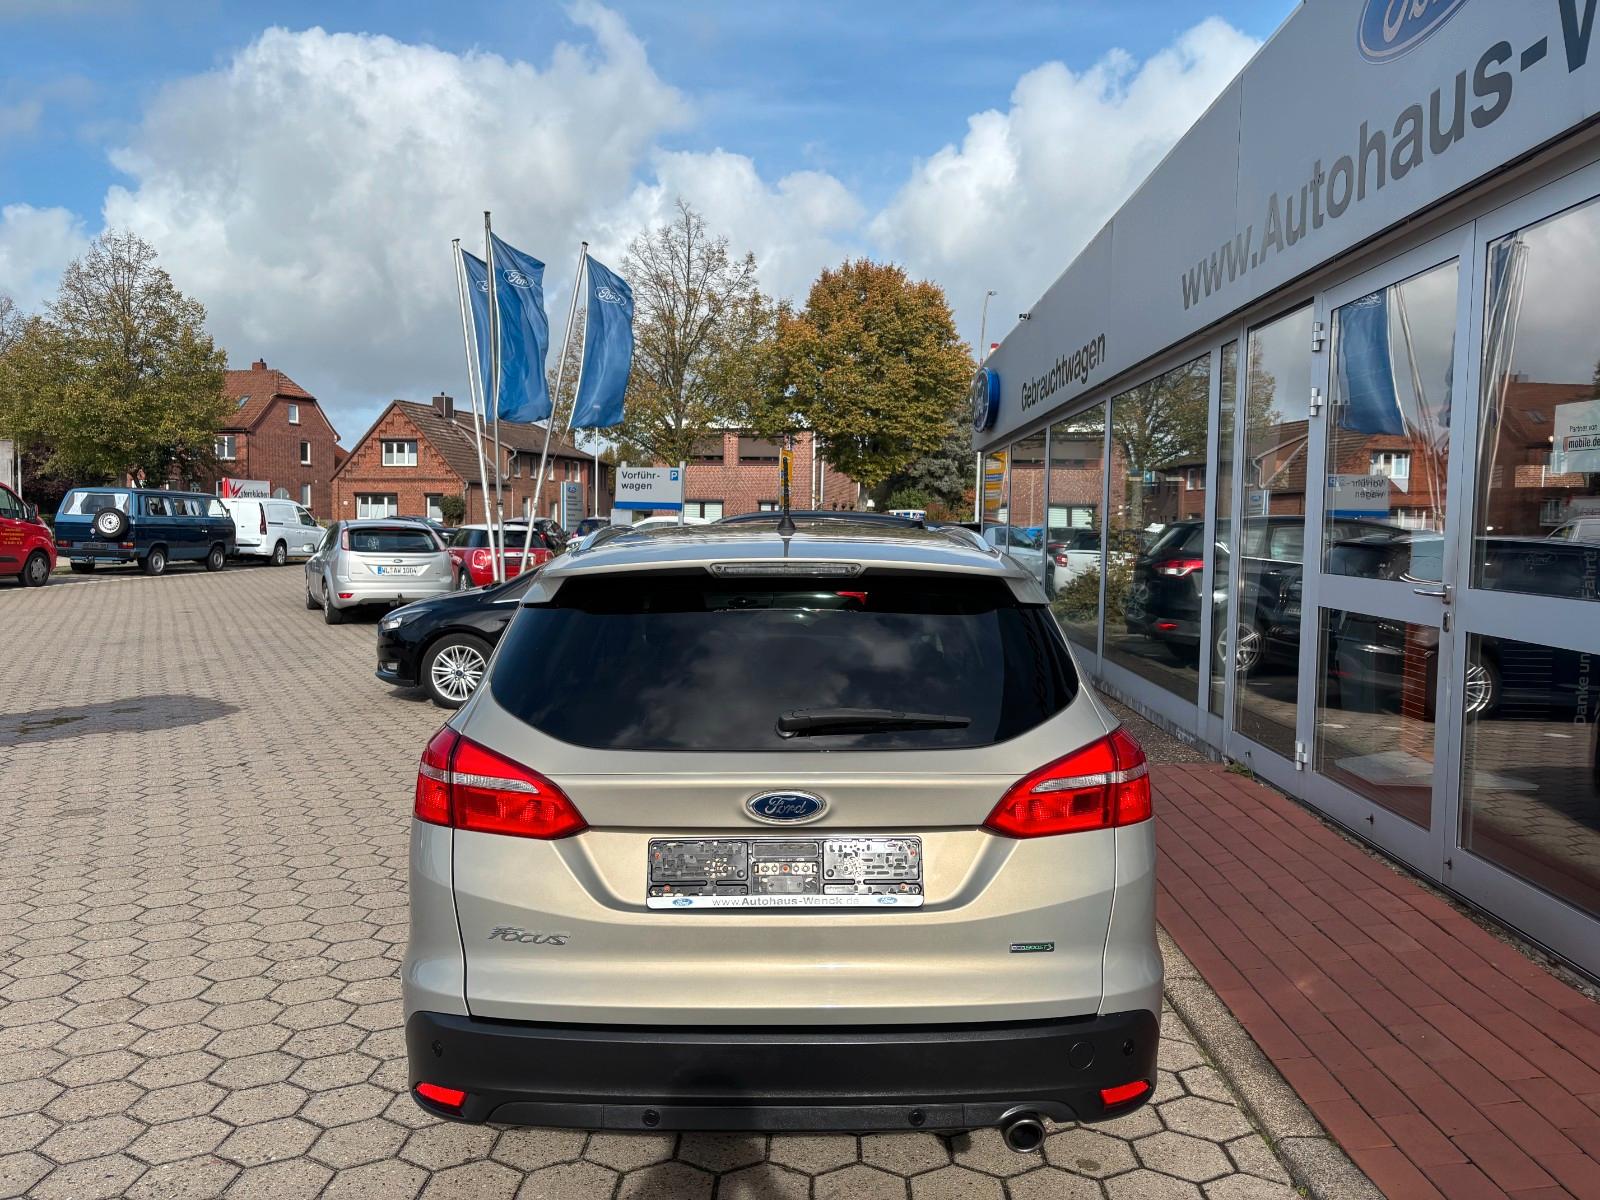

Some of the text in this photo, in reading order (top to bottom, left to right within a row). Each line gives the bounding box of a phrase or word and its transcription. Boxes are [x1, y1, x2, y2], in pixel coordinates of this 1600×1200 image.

[1021, 333, 1106, 411] Gebrauchtwagen
[621, 470, 661, 480] Vorführ-
[621, 482, 652, 491] wagen
[764, 796, 806, 814] Ford
